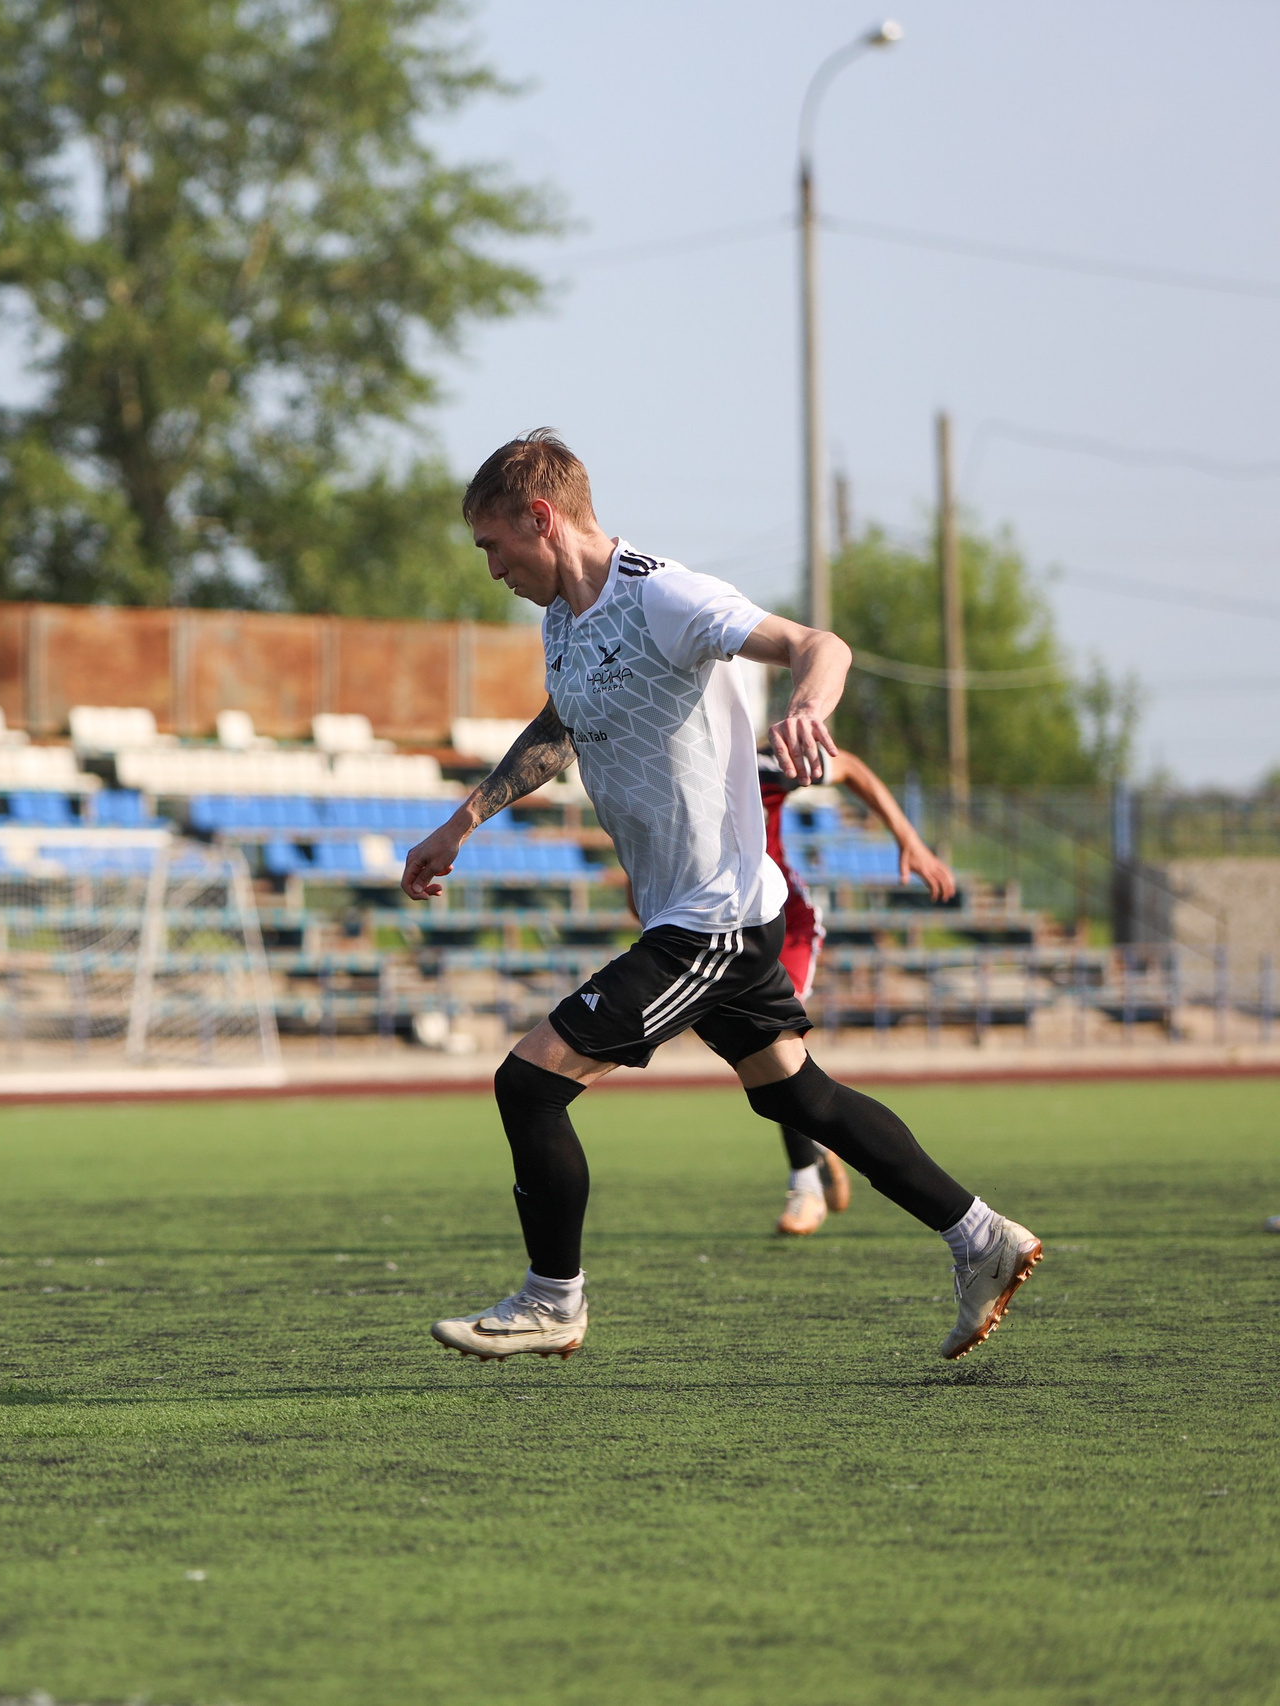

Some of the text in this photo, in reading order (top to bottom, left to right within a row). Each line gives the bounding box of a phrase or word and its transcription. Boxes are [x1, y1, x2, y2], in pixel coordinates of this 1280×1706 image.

[587, 668, 633, 685] ЧАЙКА
[592, 684, 625, 694] САМАРА
[588, 730, 608, 742] Tab
